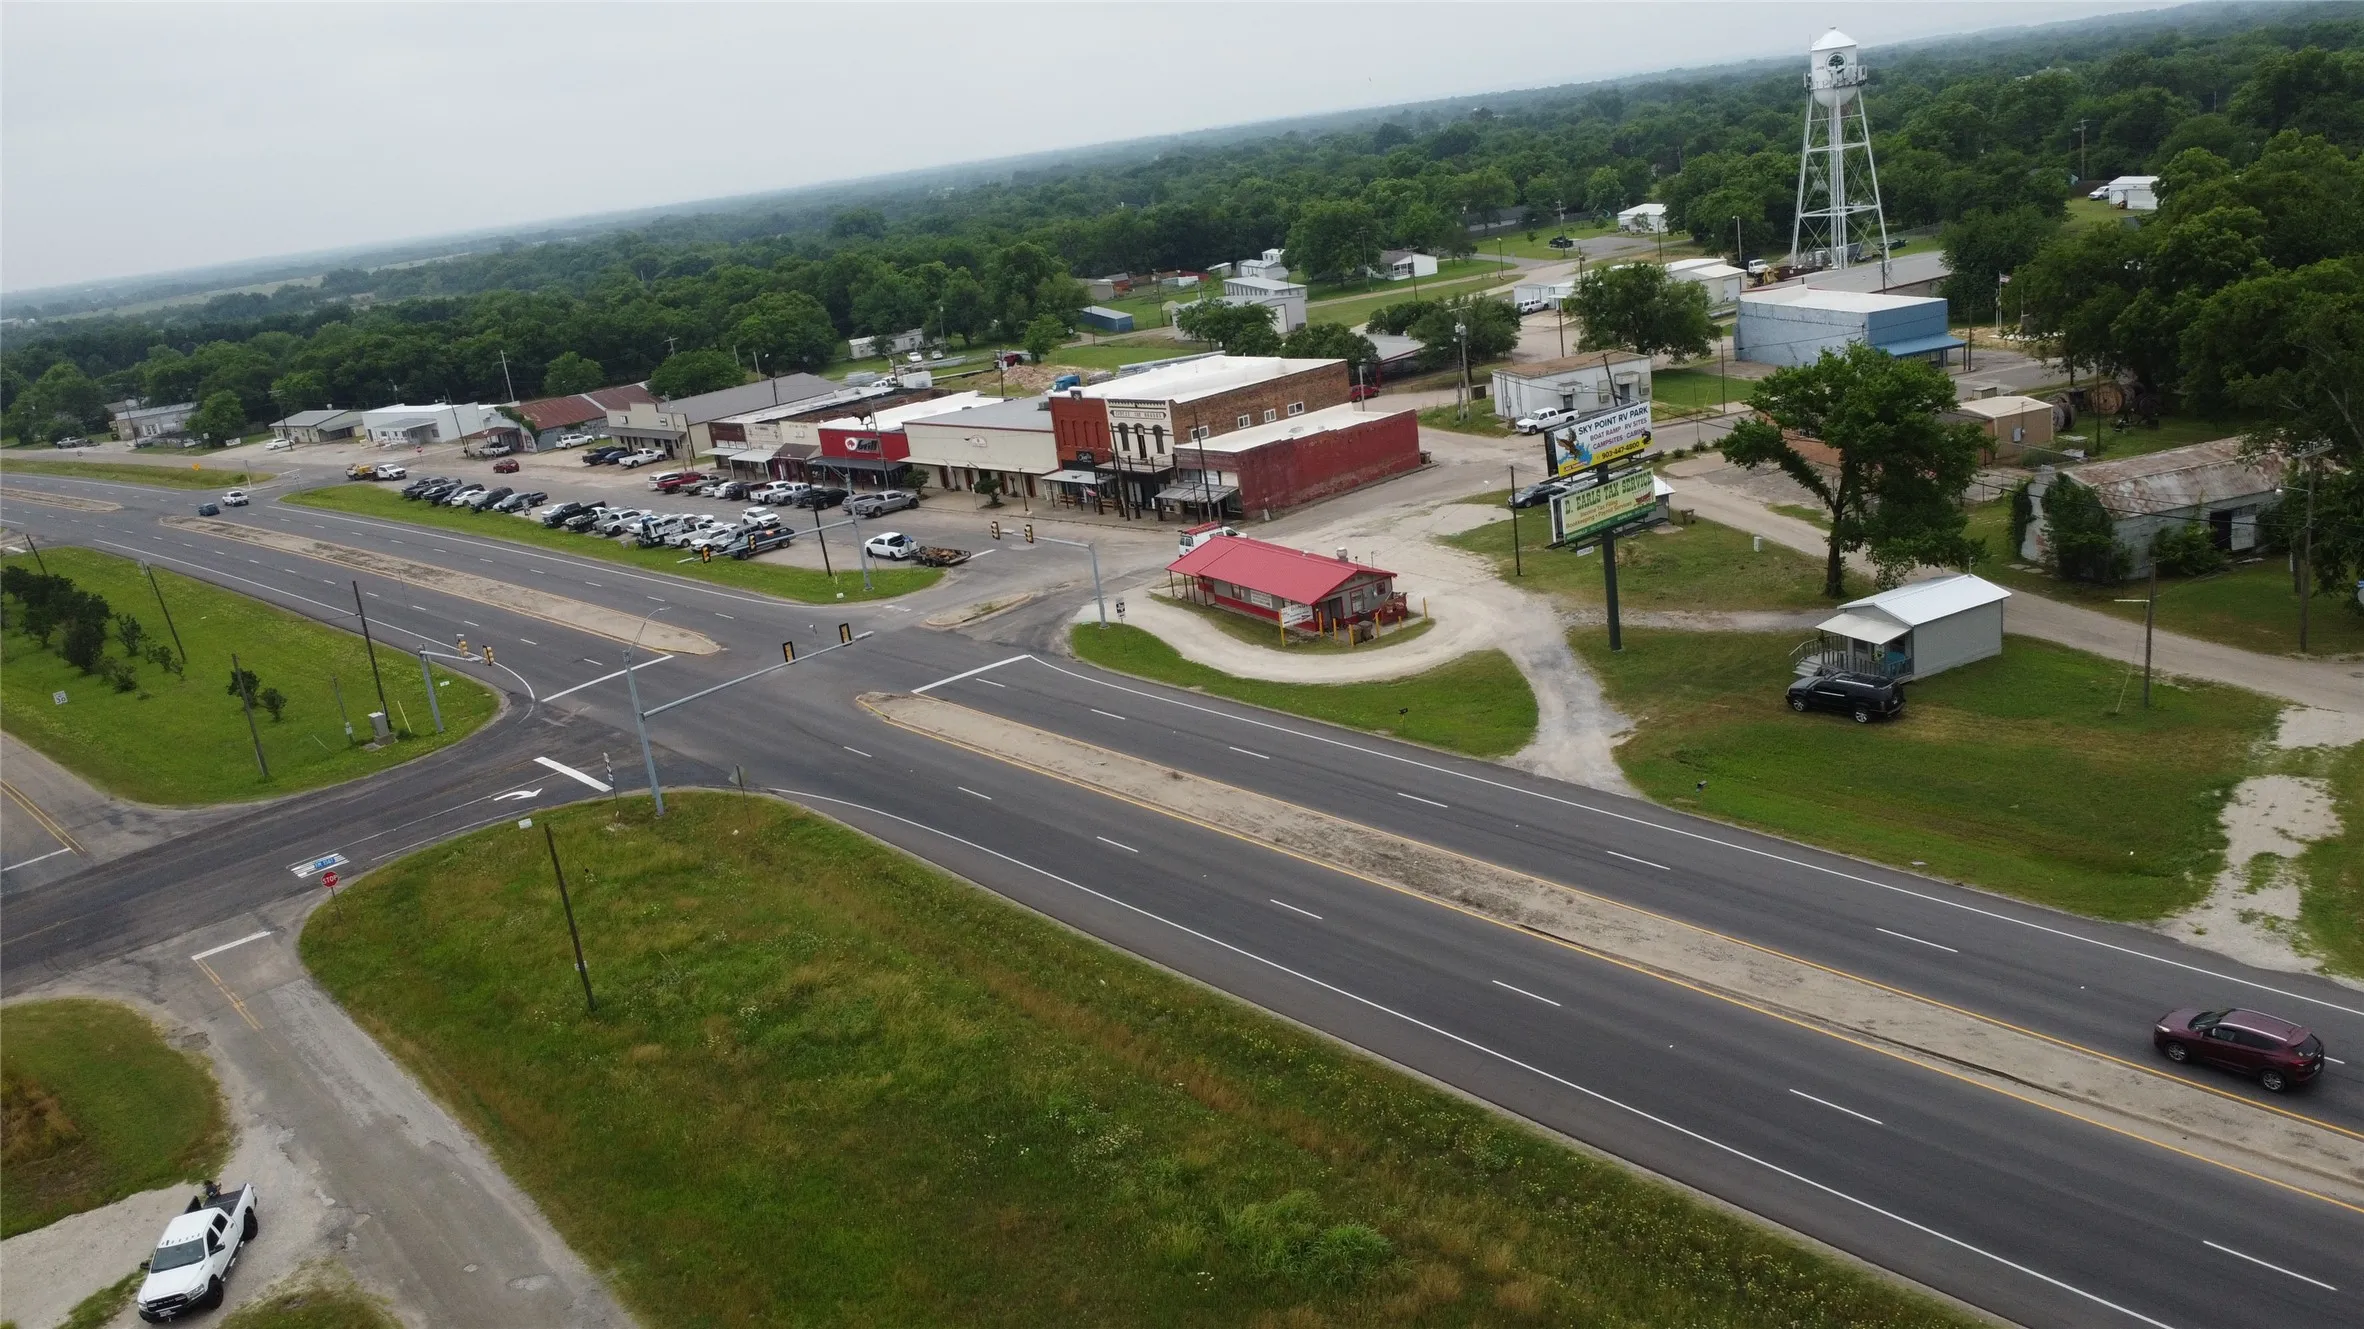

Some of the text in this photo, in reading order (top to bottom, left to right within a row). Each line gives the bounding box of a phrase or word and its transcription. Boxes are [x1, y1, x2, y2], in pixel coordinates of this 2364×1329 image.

[1578, 406, 1648, 435] SKY POINT RV PARK
[1590, 433, 1605, 441] BOAT
[1606, 426, 1622, 436] RAMP
[1633, 418, 1647, 426] SITES
[856, 440, 877, 450] Grill
[1592, 435, 1623, 449] CAMPSITES
[1565, 471, 1652, 514] D. EARLS TAX SERVICE
[322, 875, 338, 884] STOP
